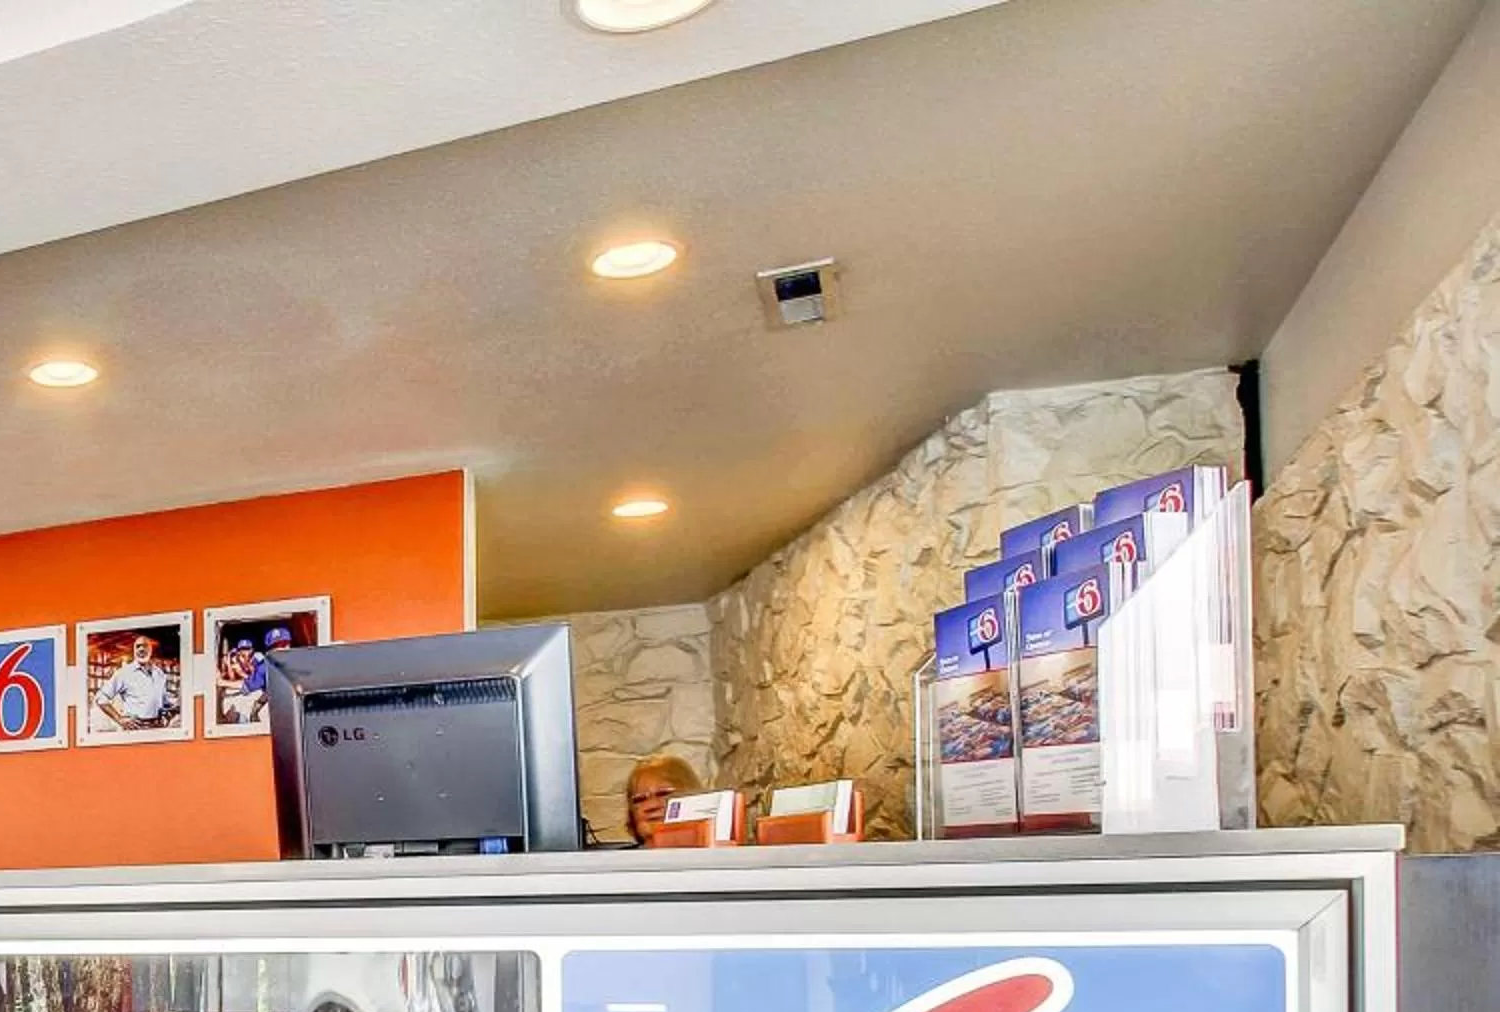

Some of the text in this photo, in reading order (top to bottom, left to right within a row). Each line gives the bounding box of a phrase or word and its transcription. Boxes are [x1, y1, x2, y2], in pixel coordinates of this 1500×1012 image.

[1113, 530, 1136, 562] 6
[1076, 578, 1101, 617] 6
[977, 608, 999, 643] 6
[343, 727, 365, 741] LG
